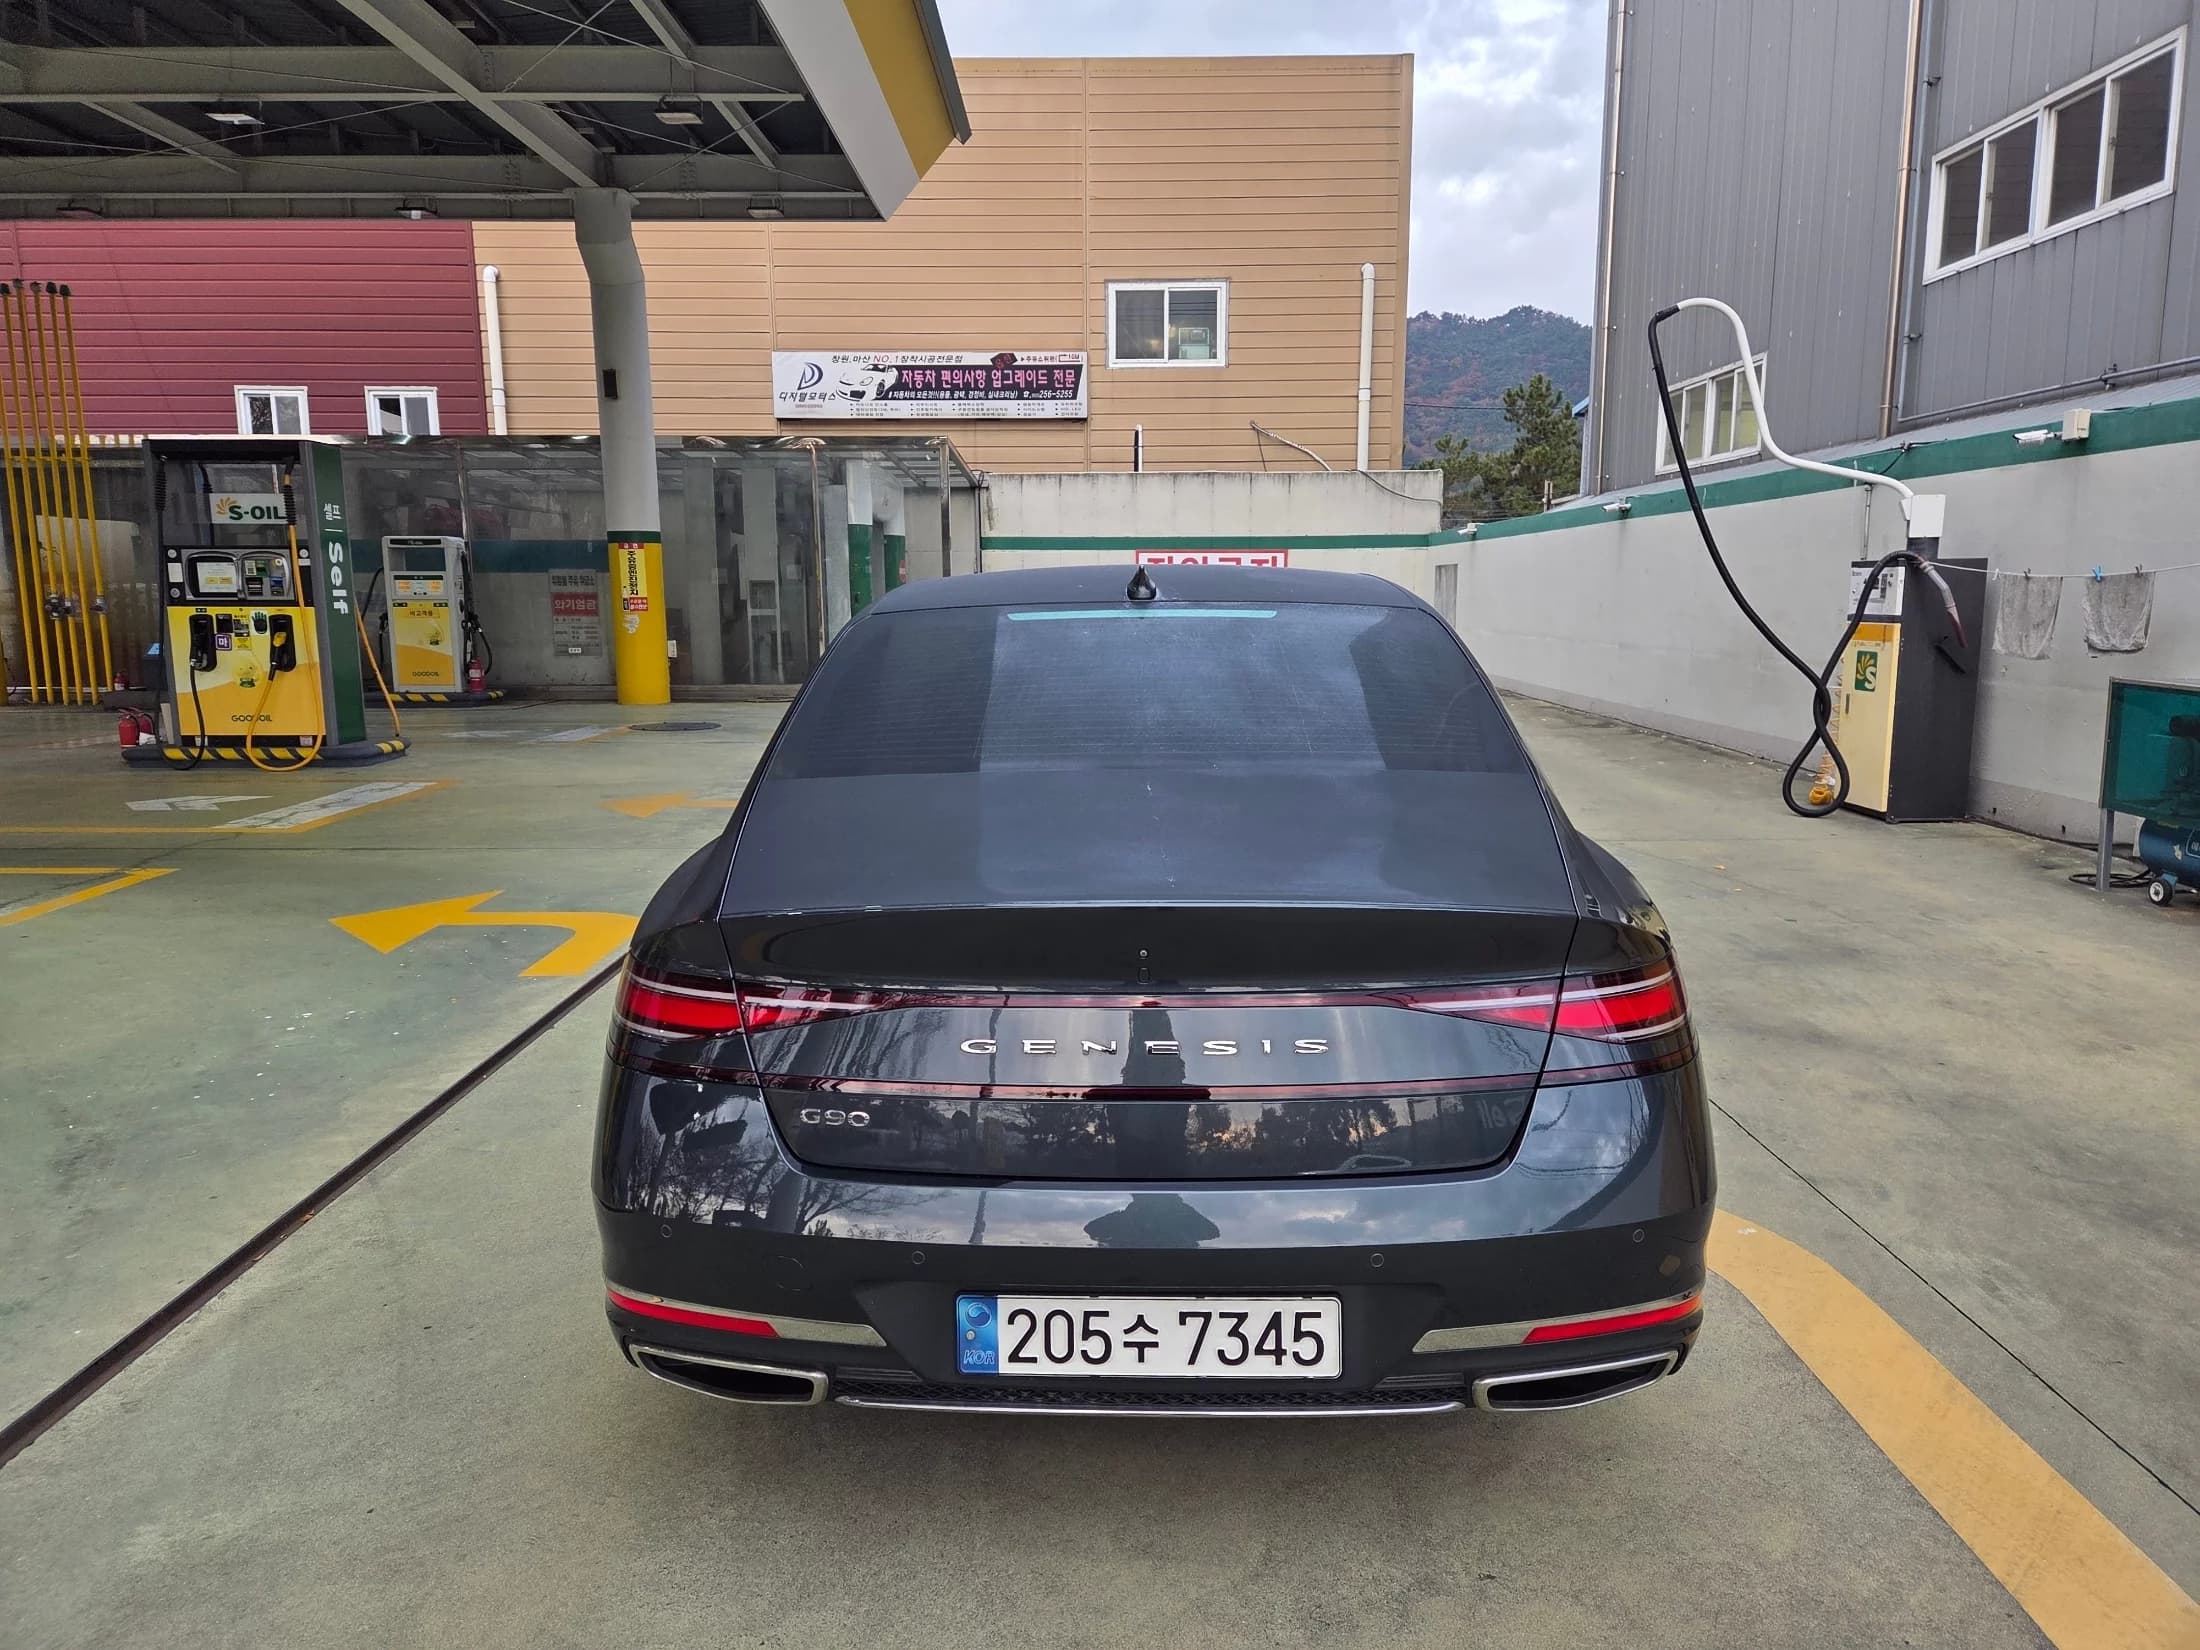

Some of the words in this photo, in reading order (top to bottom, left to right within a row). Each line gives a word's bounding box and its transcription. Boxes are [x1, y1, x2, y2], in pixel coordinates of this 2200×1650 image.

[901, 369, 936, 389] 자동차
[941, 369, 986, 389] 편의사항
[991, 369, 1048, 389] 업그레이드
[1053, 369, 1075, 388] 전문
[778, 391, 836, 403] 디지털모터스
[228, 504, 288, 521] S-OIL
[328, 541, 349, 615] Self
[554, 599, 596, 610] 화기엄금
[231, 714, 273, 722] GOOOIL
[960, 1038, 1330, 1057] GENESIS
[799, 1108, 872, 1128] G90
[1006, 1308, 1160, 1366] 205수
[1178, 1310, 1325, 1367] 7345
[963, 1349, 995, 1365] KOR
